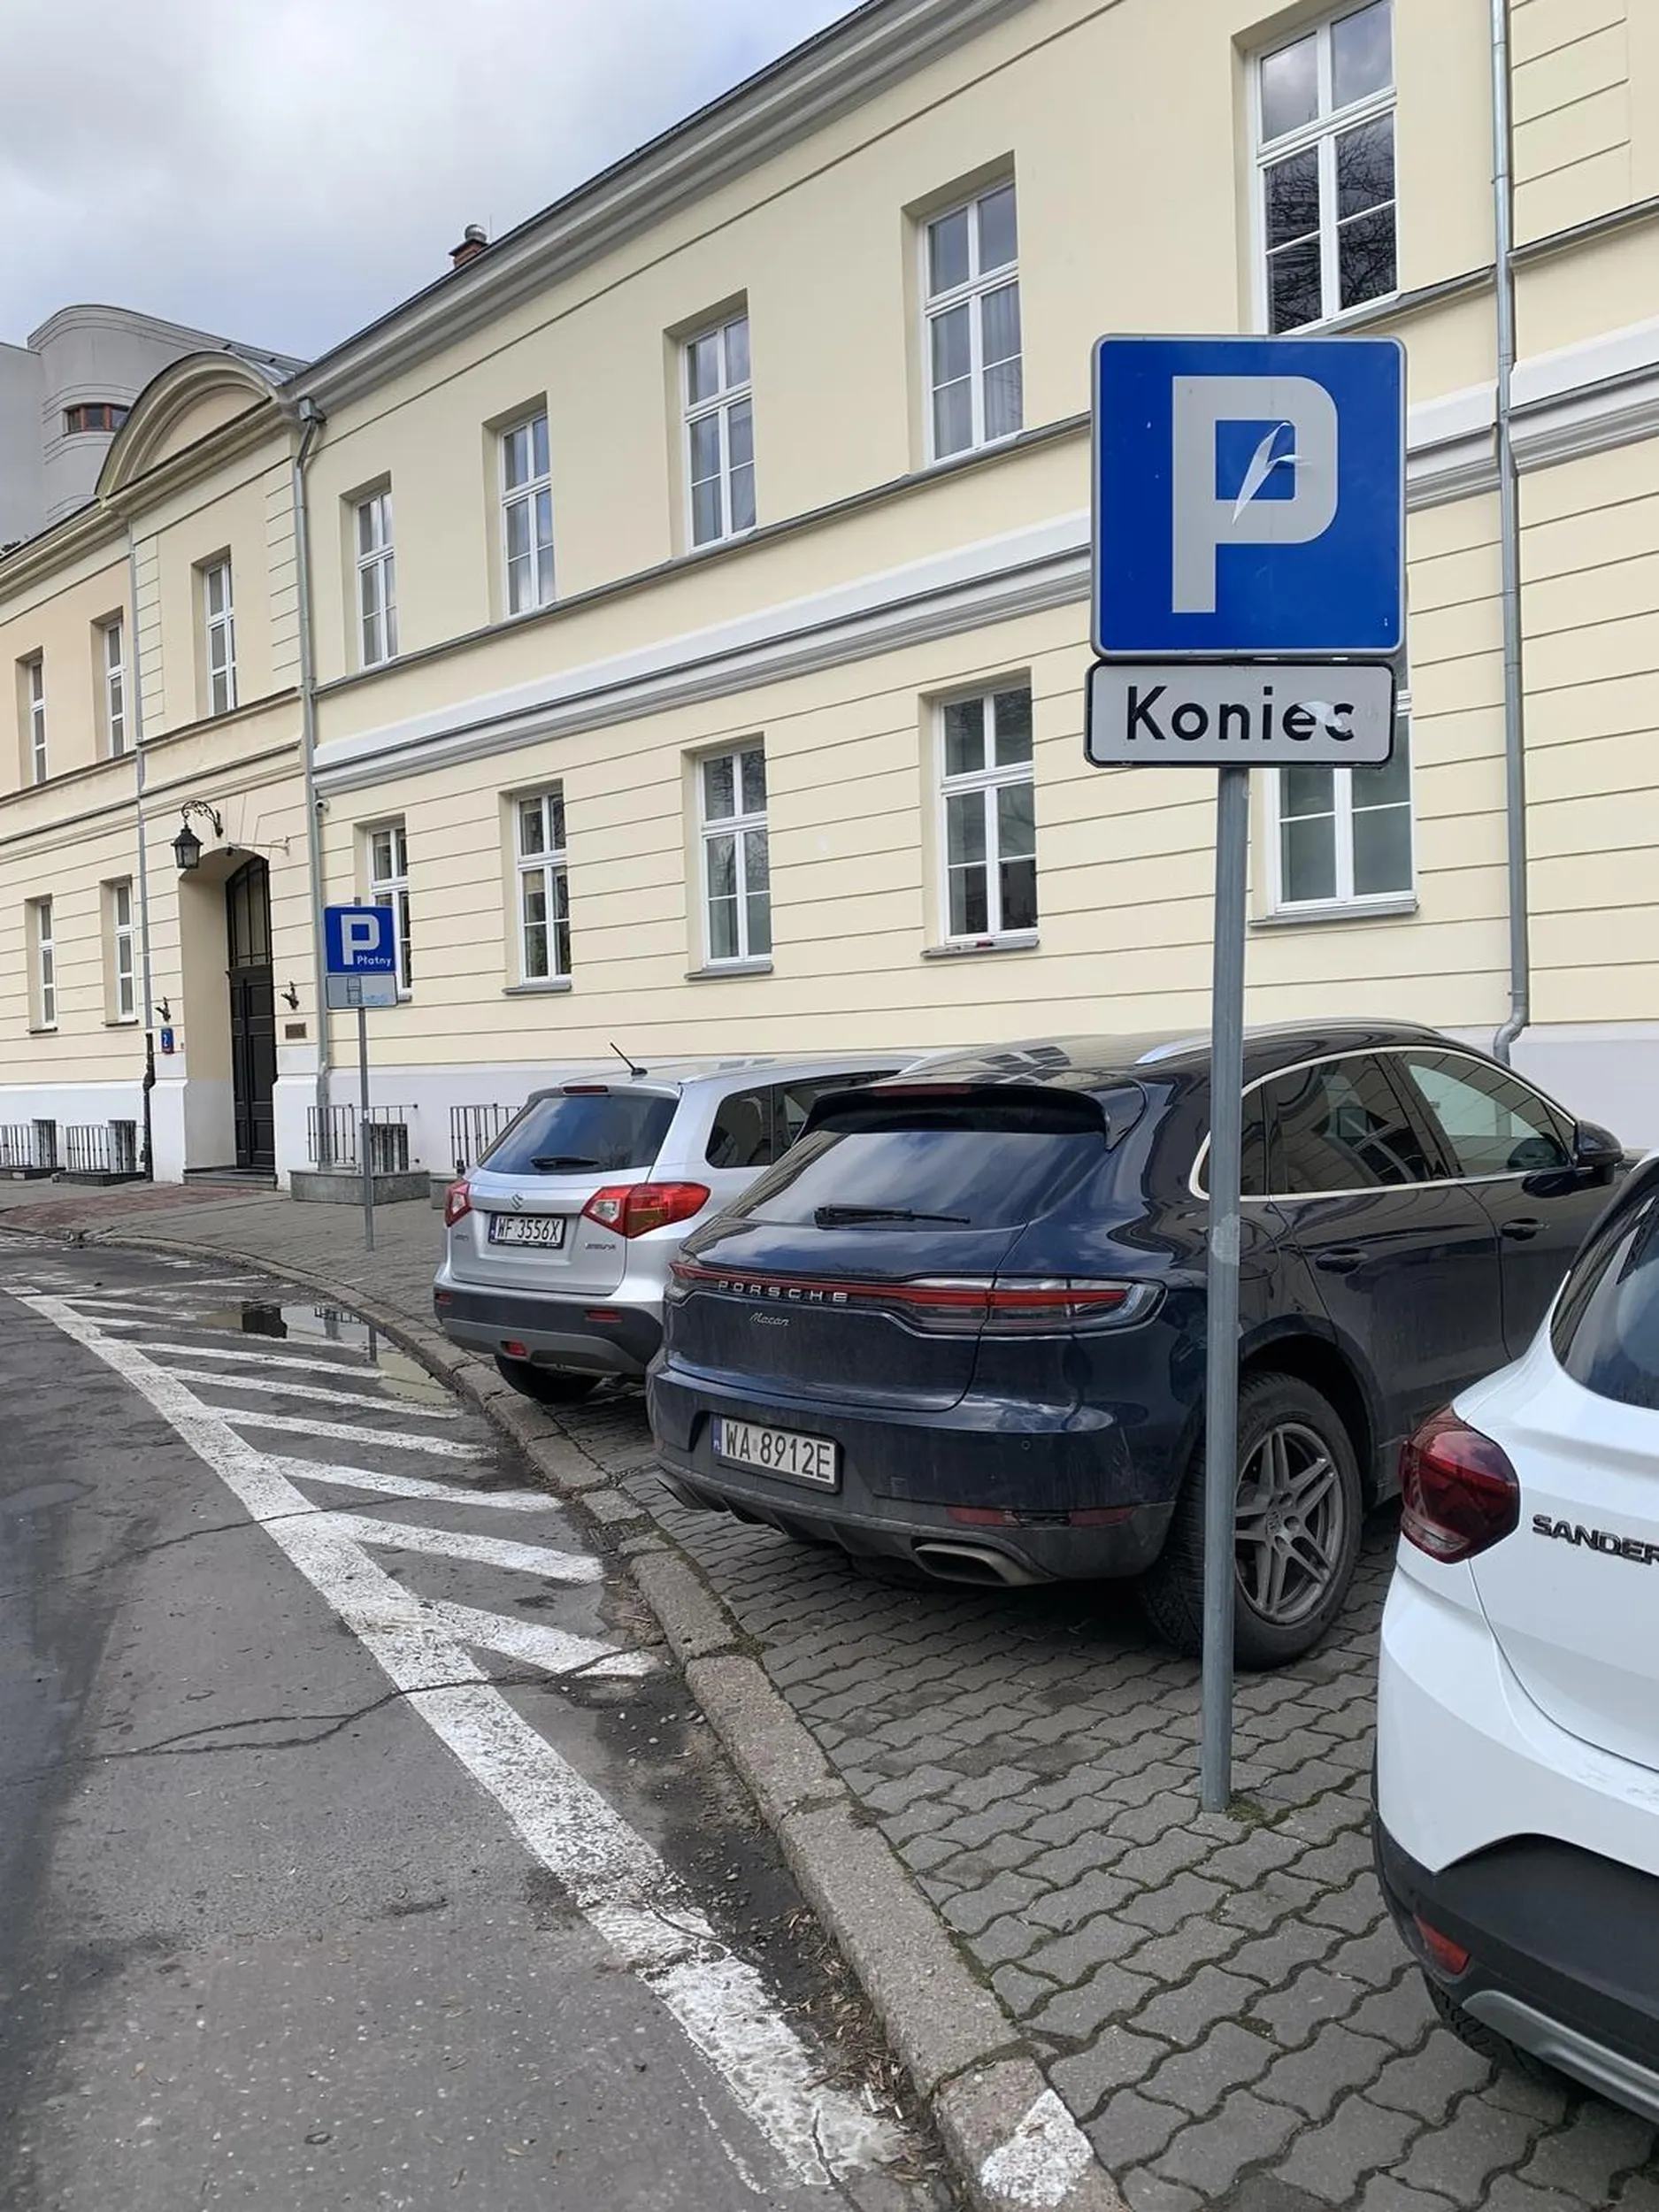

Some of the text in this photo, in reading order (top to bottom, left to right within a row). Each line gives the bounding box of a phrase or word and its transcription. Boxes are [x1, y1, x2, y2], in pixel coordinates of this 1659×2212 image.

[1172, 375, 1339, 614] P
[1125, 685, 1355, 741] Koniec
[341, 914, 380, 965] P
[357, 956, 393, 967] Płatny
[518, 1219, 561, 1242] 3556X
[718, 1280, 849, 1303] PORSCHE
[749, 1312, 790, 1326] Macan
[726, 1423, 831, 1480] WA 8912E
